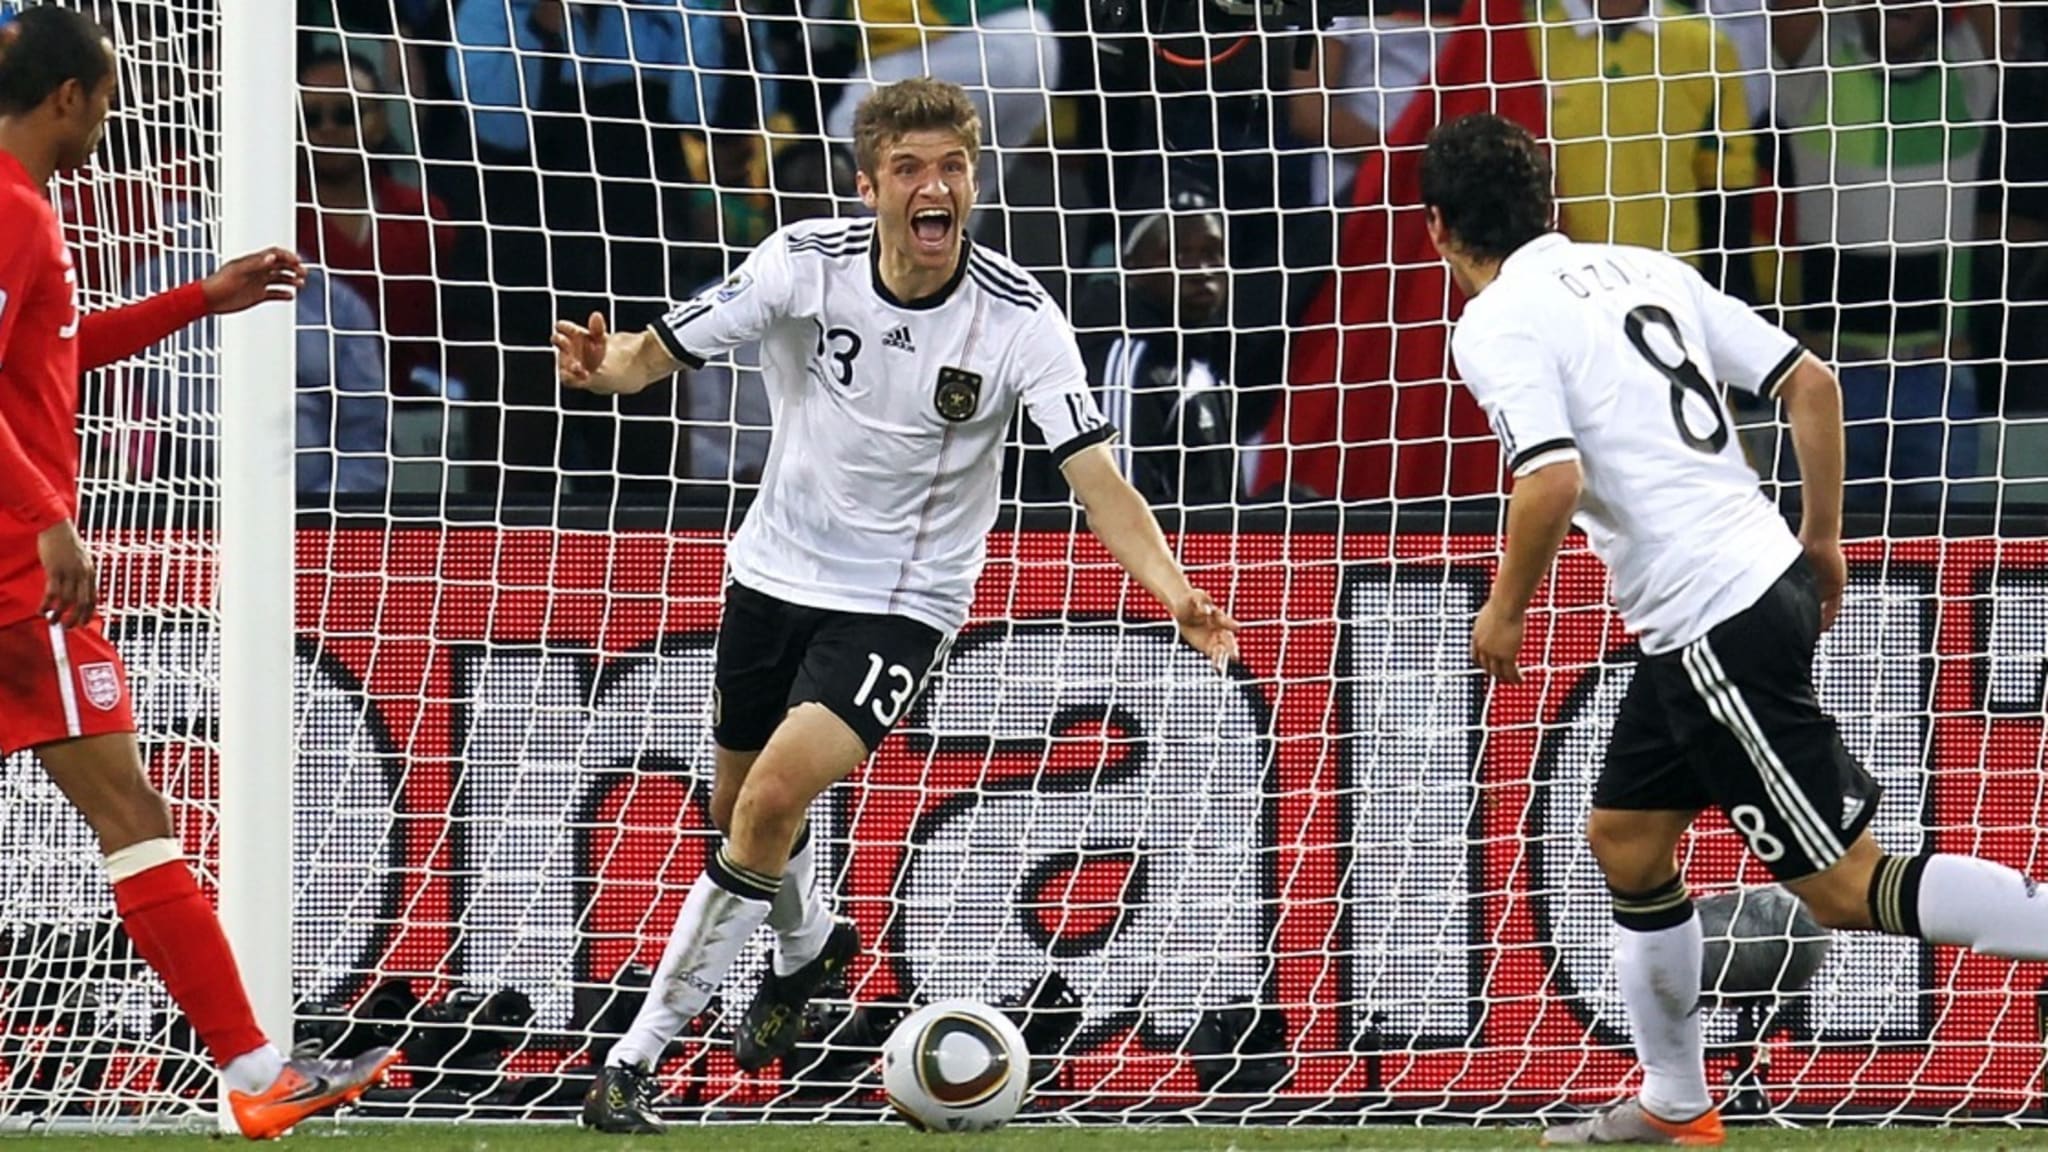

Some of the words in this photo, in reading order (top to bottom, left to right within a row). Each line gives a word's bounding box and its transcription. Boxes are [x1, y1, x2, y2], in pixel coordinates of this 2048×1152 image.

[1623, 304, 1729, 455] 8
[853, 652, 914, 727] 13
[1731, 804, 1785, 862] 8
